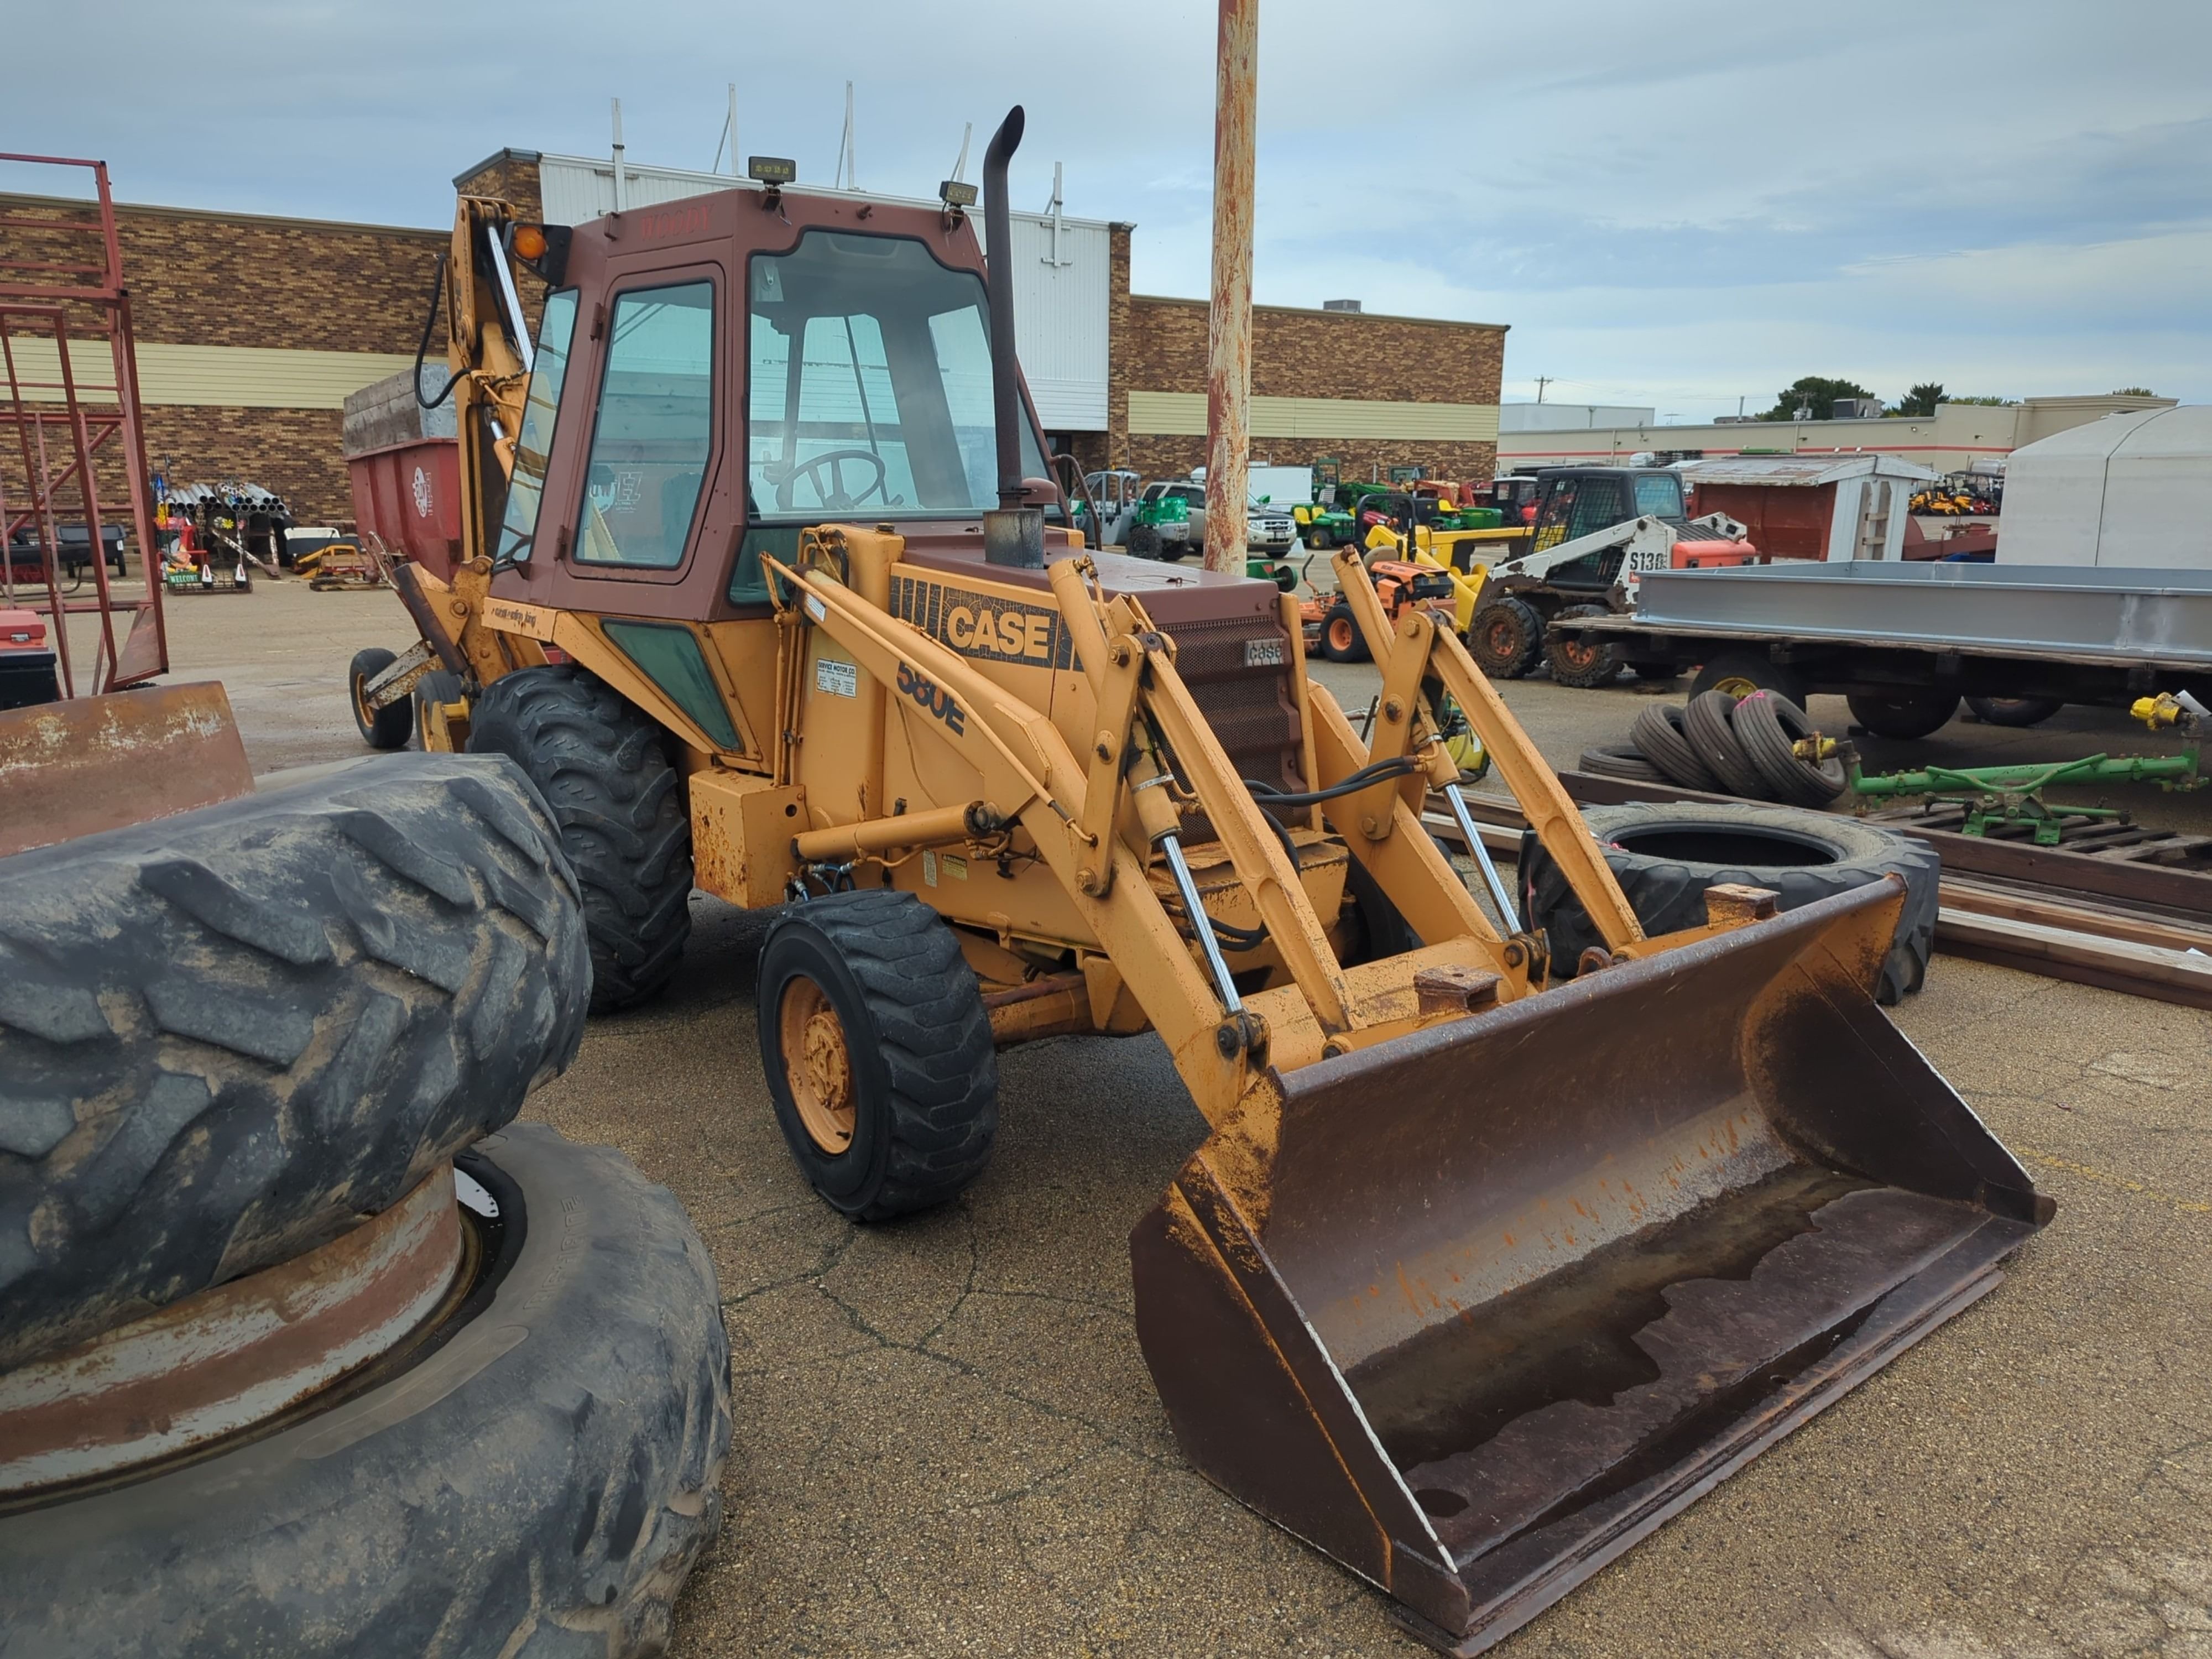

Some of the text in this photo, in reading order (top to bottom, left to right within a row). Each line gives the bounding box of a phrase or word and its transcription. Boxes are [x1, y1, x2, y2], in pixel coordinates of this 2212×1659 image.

[169, 575, 199, 583] WELCOME
[947, 606, 1050, 659] CASE
[1250, 646, 1283, 660] case
[818, 661, 832, 670] SERVICE
[833, 665, 848, 673] MOTOR
[896, 660, 965, 738] 580E
